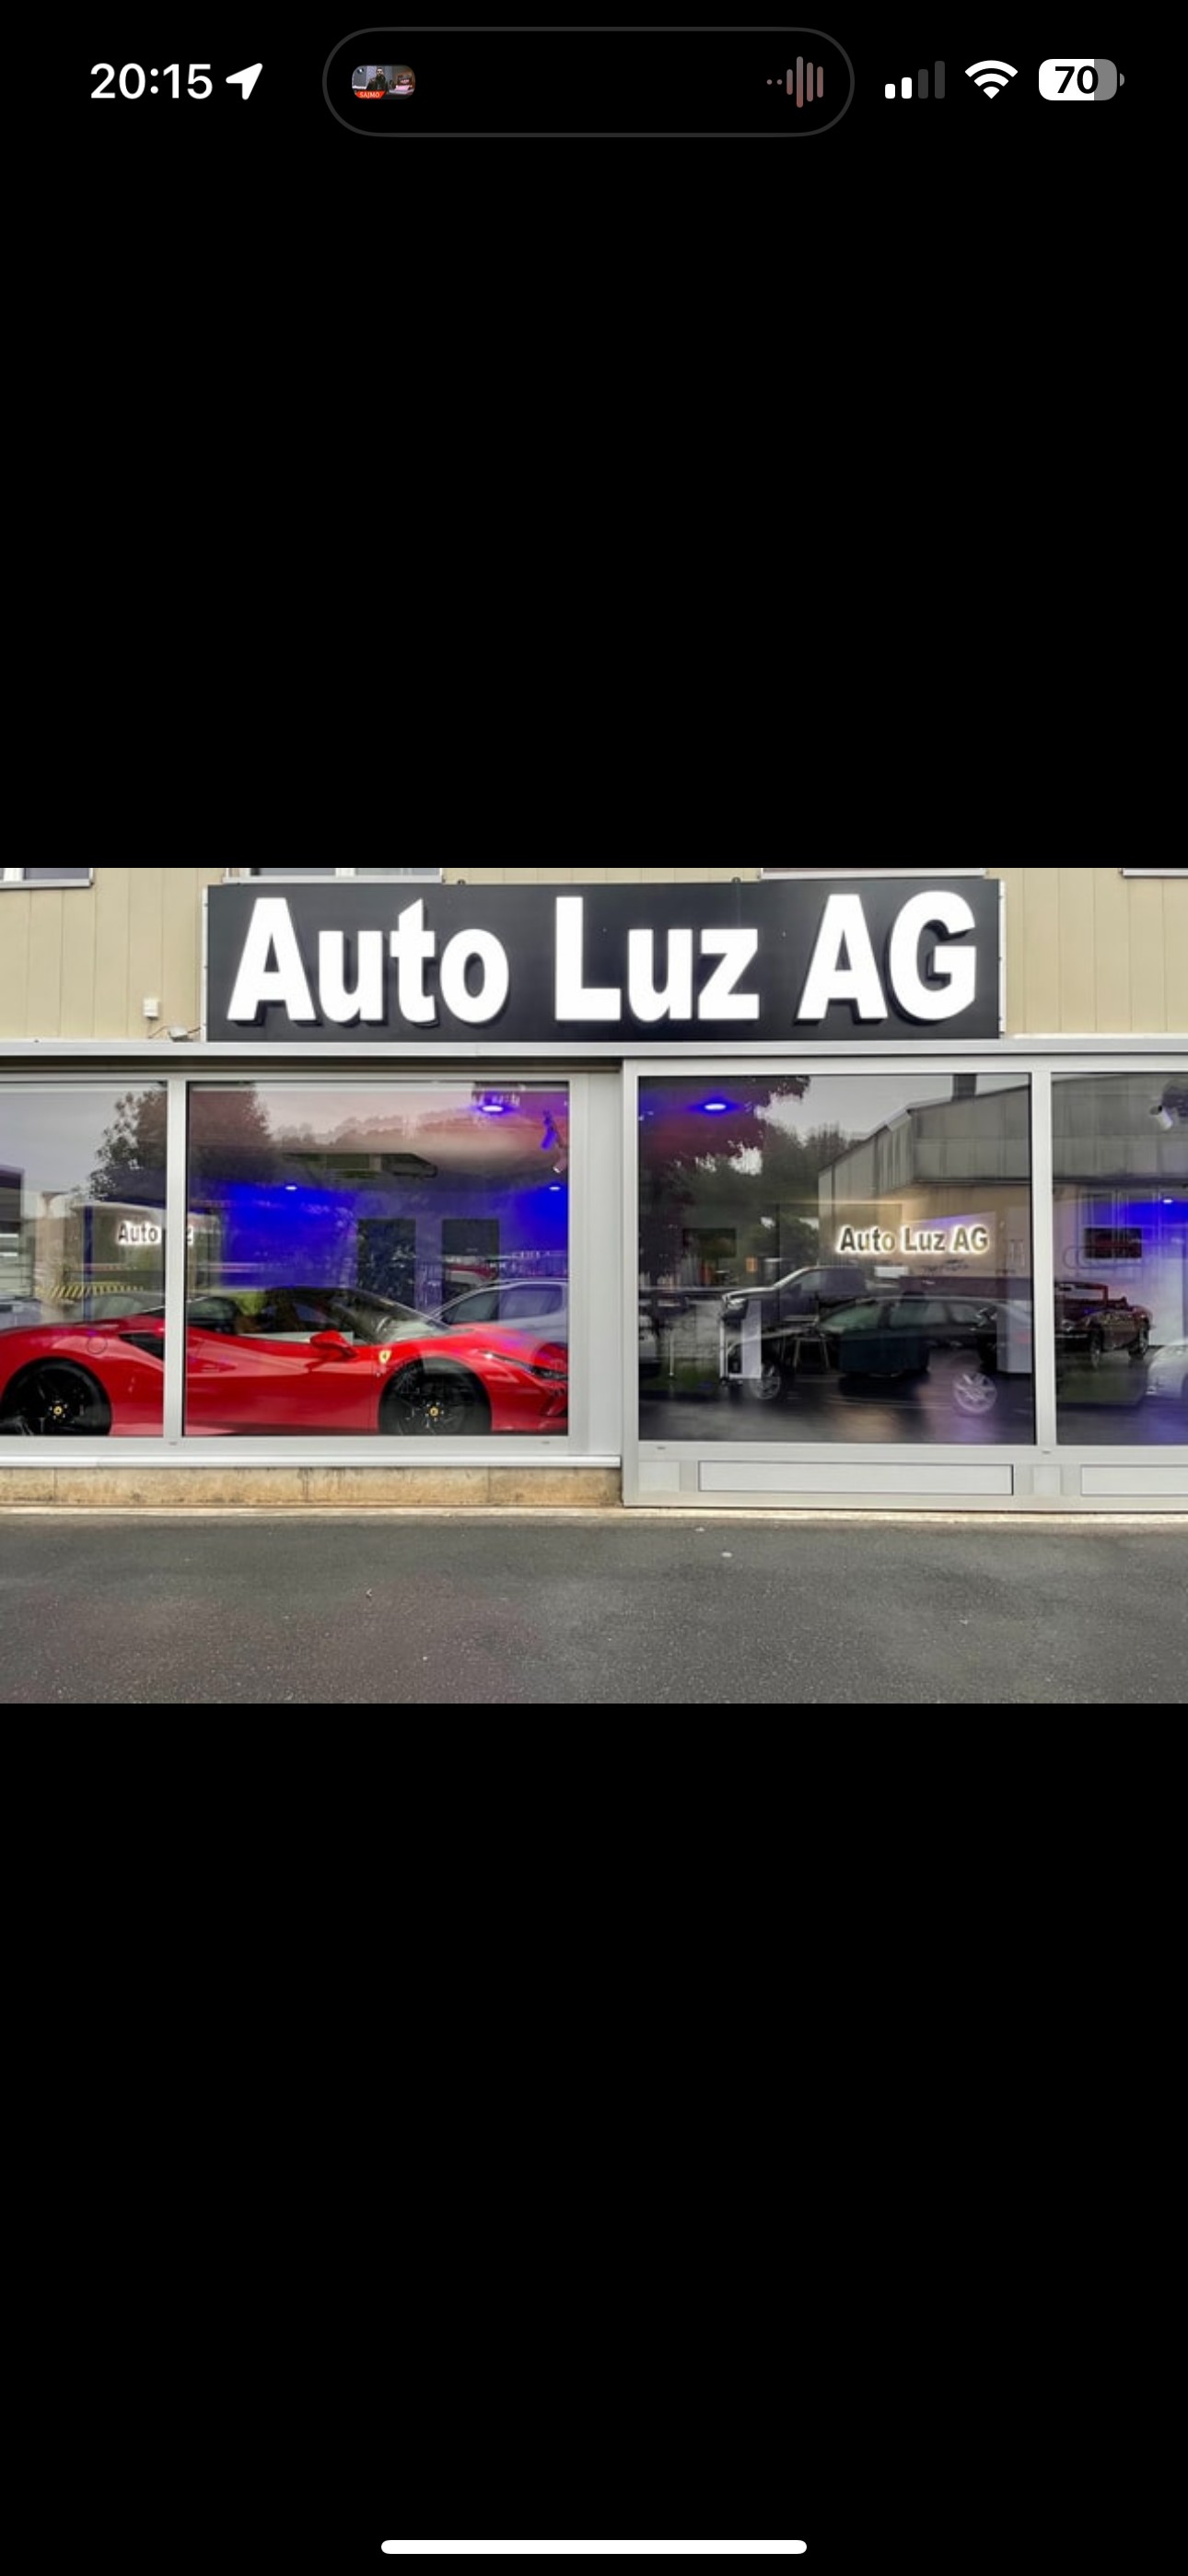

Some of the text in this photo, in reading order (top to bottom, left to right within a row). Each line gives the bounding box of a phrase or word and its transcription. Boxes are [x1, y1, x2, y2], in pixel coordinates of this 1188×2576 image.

[227, 890, 977, 1024] Auto Luz AG
[117, 1222, 160, 1243] Auto
[839, 1226, 989, 1253] Auto Luz AG
